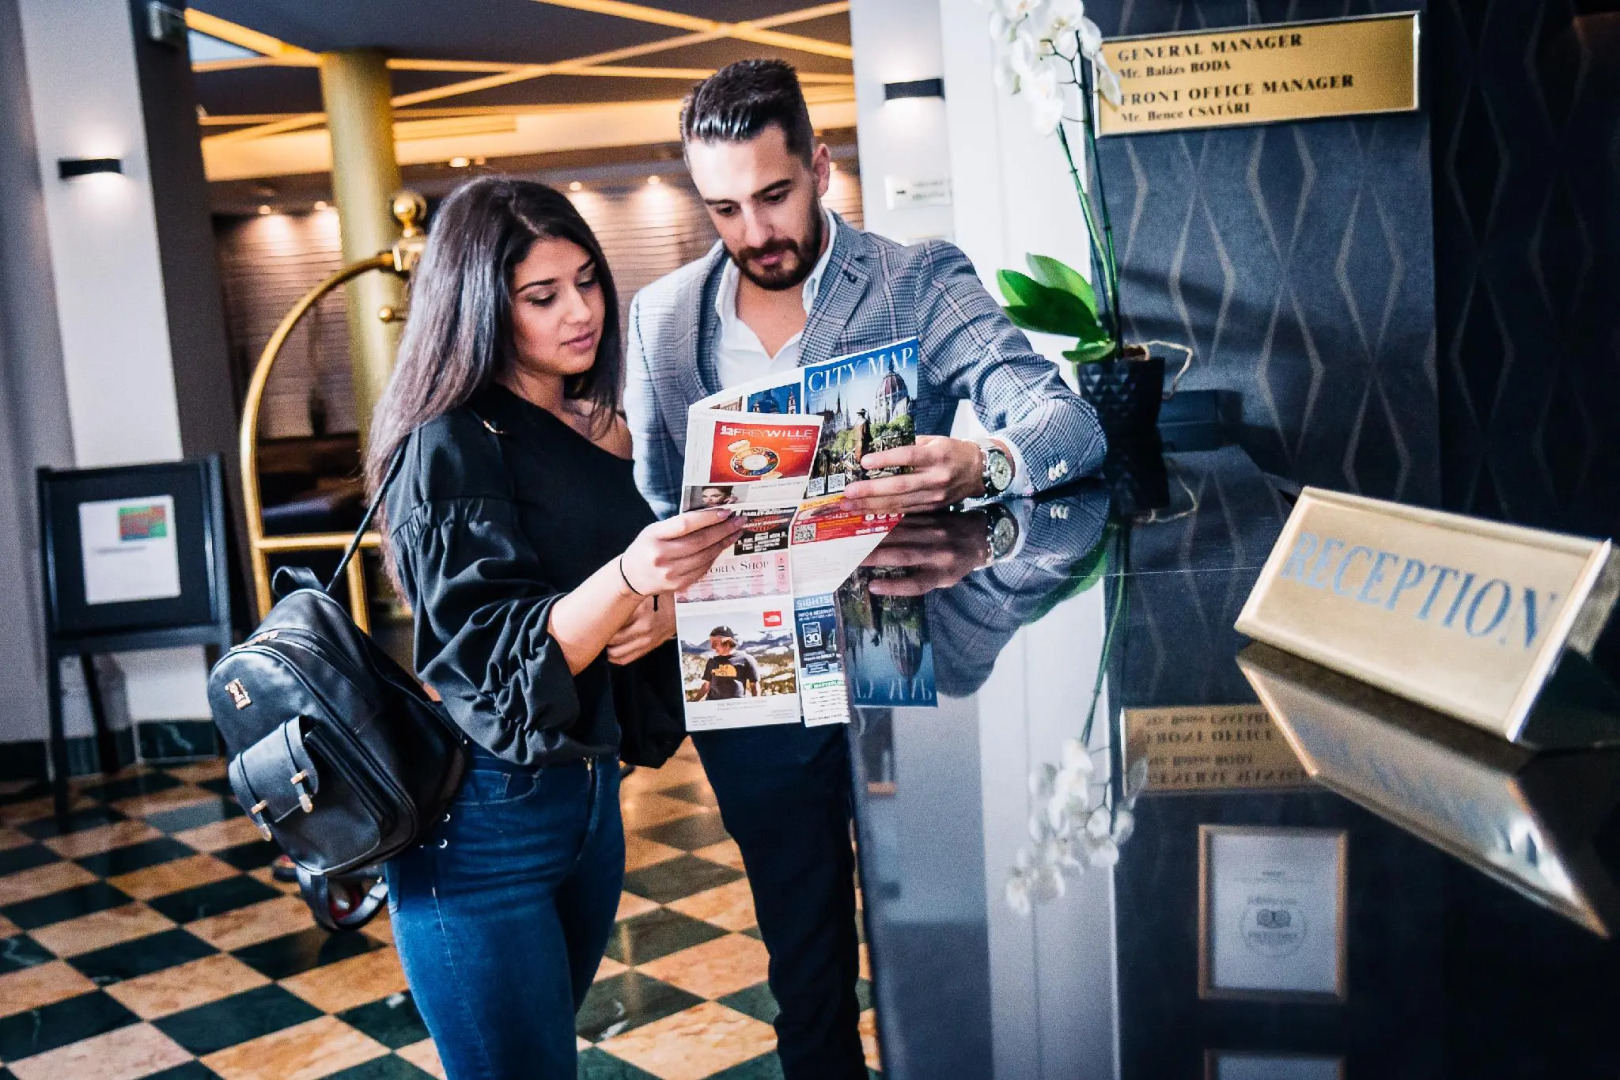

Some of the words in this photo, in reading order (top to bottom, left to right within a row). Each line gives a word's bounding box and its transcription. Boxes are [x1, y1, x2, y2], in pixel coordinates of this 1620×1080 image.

[1118, 43, 1203, 61] GENERAL
[1211, 33, 1303, 53] MANAGER
[1119, 67, 1140, 78] Mr.
[1146, 65, 1185, 77] Balázs
[1190, 60, 1231, 73] BODA
[1121, 90, 1181, 106] FRONT
[1188, 83, 1254, 100] OFFICE
[1262, 74, 1354, 94] MANAGER
[1122, 112, 1140, 122] Mr.
[1147, 111, 1183, 121] Bence
[1188, 101, 1250, 118] CSATÁRI
[807, 360, 862, 393] CITY
[867, 347, 914, 376] MAP
[734, 428, 813, 438] FREYWILLE
[1280, 531, 1557, 649] RECEPTION
[805, 633, 820, 643] 30
